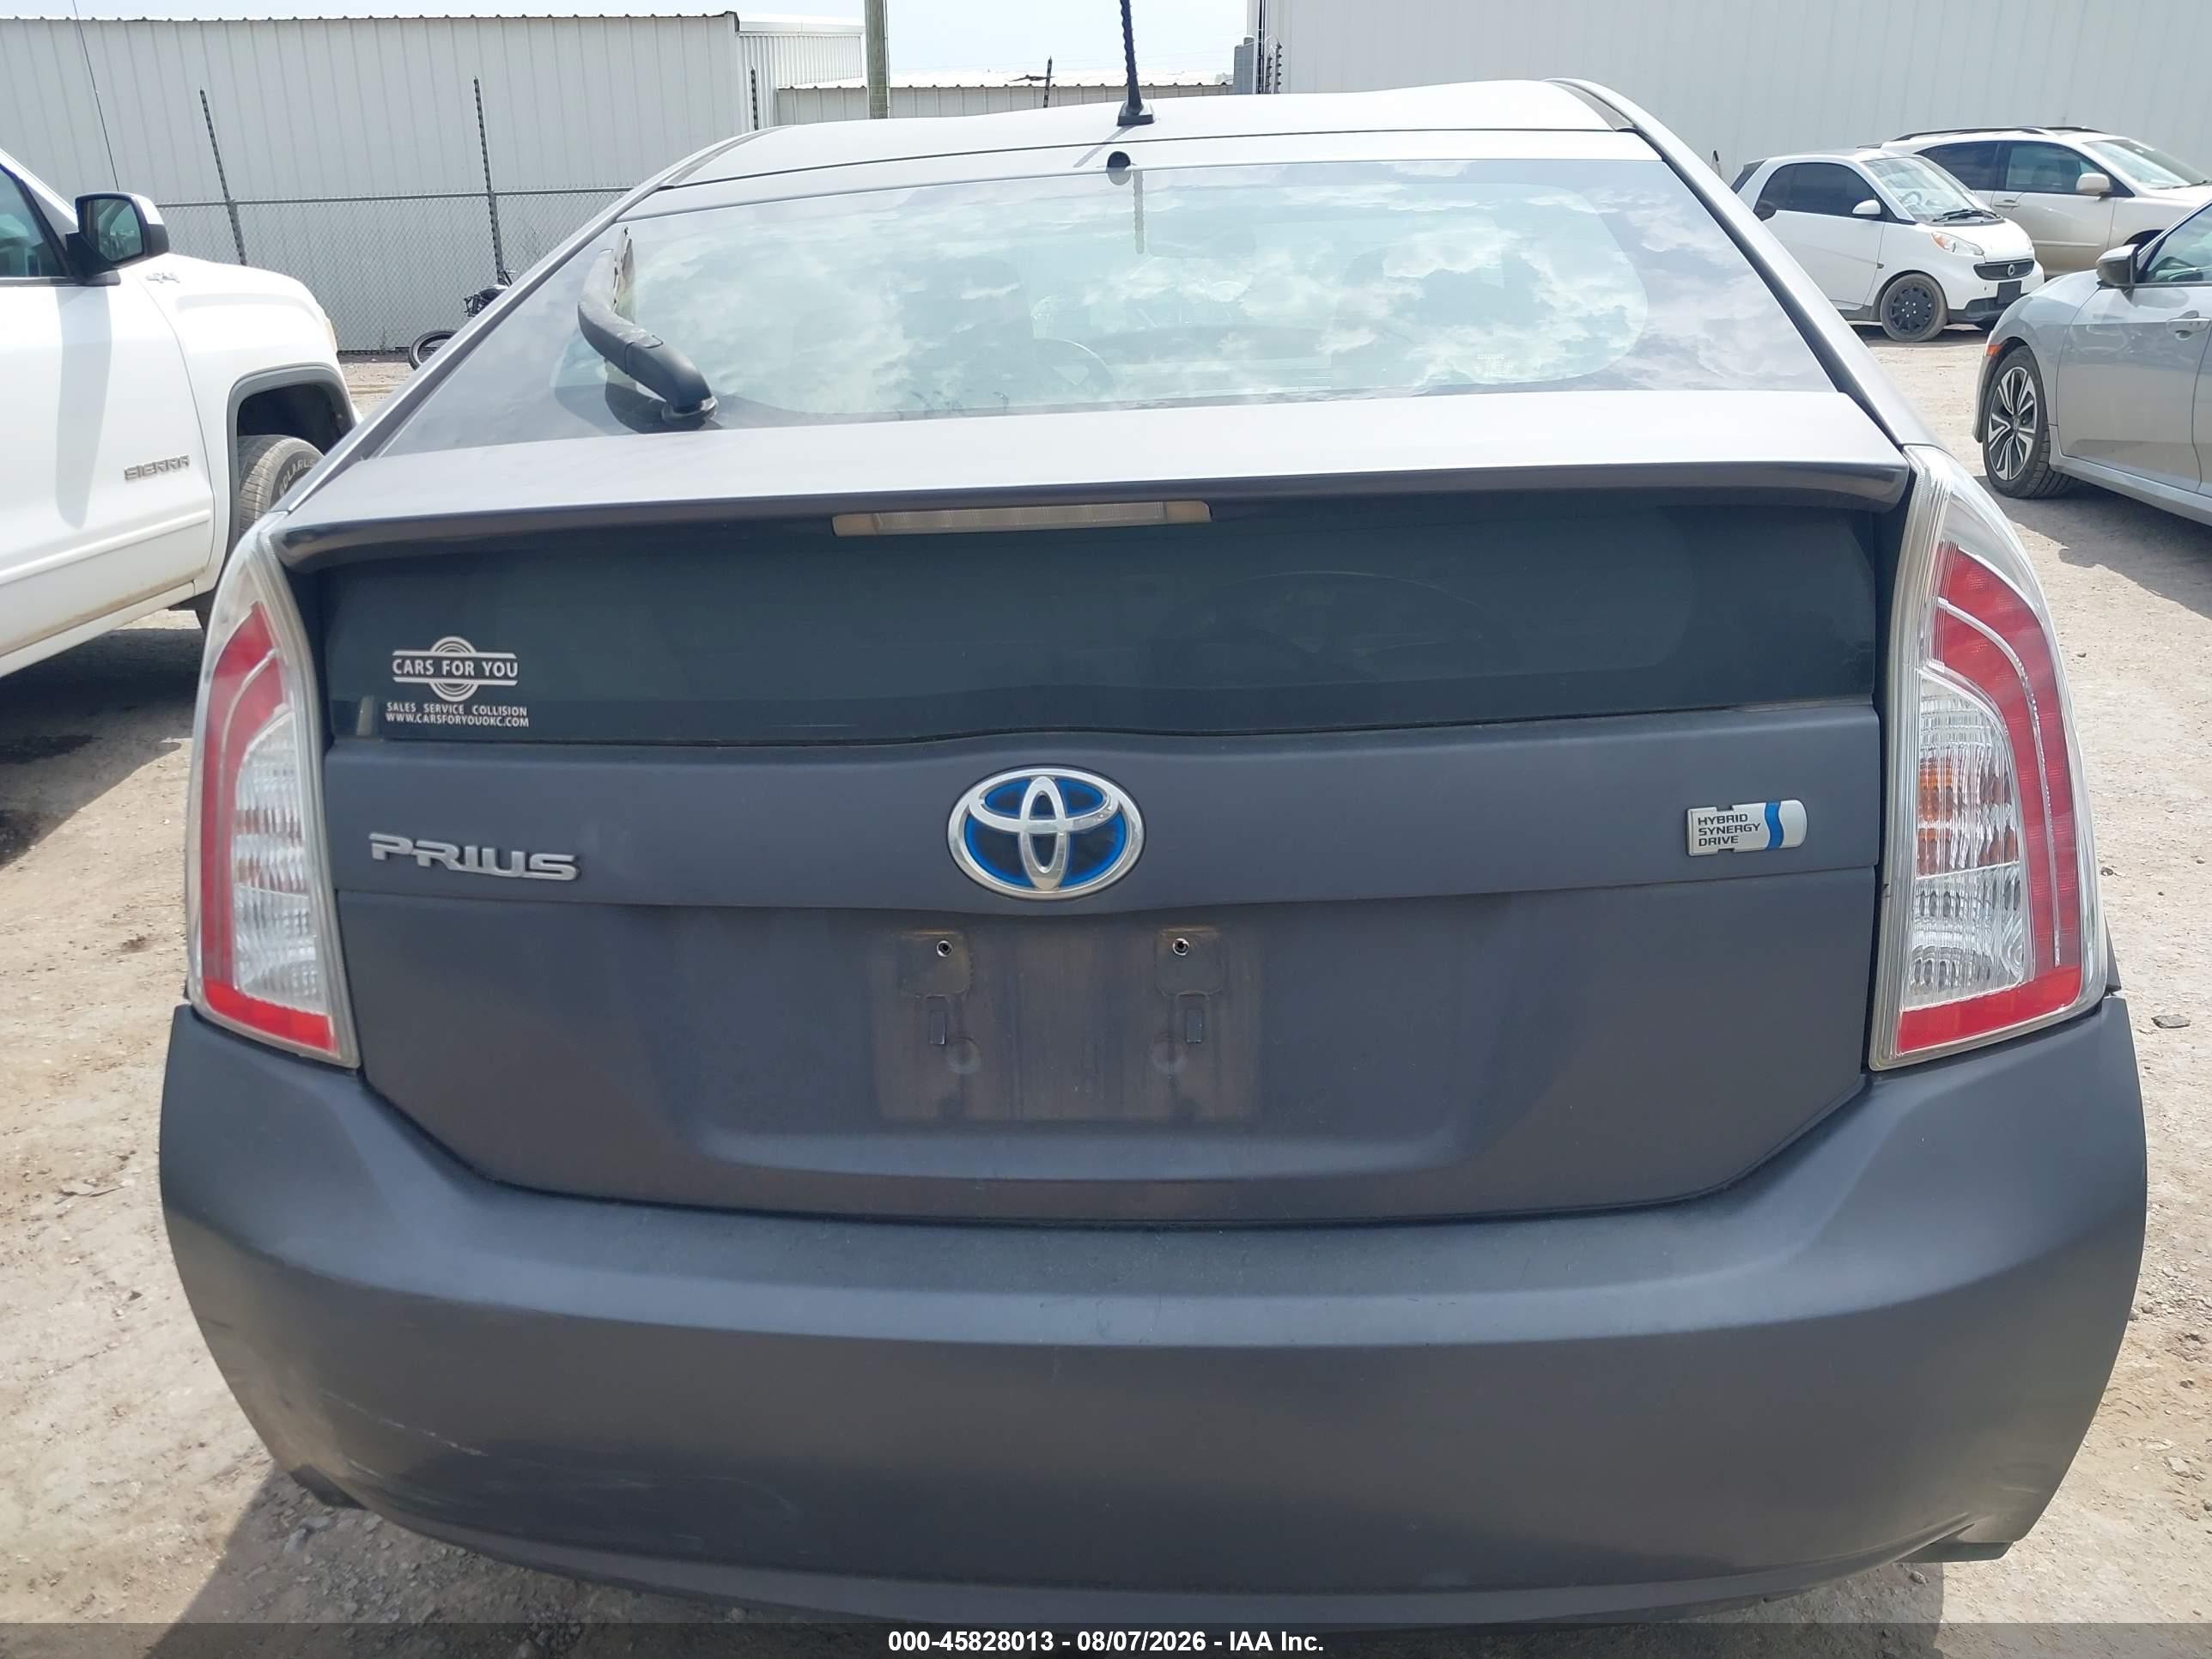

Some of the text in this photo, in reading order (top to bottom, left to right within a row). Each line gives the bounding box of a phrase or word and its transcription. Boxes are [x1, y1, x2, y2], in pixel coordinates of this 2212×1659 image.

[124, 455, 191, 481] SIERRA
[392, 659, 519, 678] CARS FOR YOU
[386, 702, 527, 716] SALES SERVICE COLLISION
[386, 713, 529, 727] WWW.CARSFORYOUOKC.COM
[1698, 814, 1748, 826] HYBRID
[1698, 823, 1761, 836] SYNERGY
[1698, 836, 1739, 847] DRIVE
[368, 832, 578, 881] PRIUS
